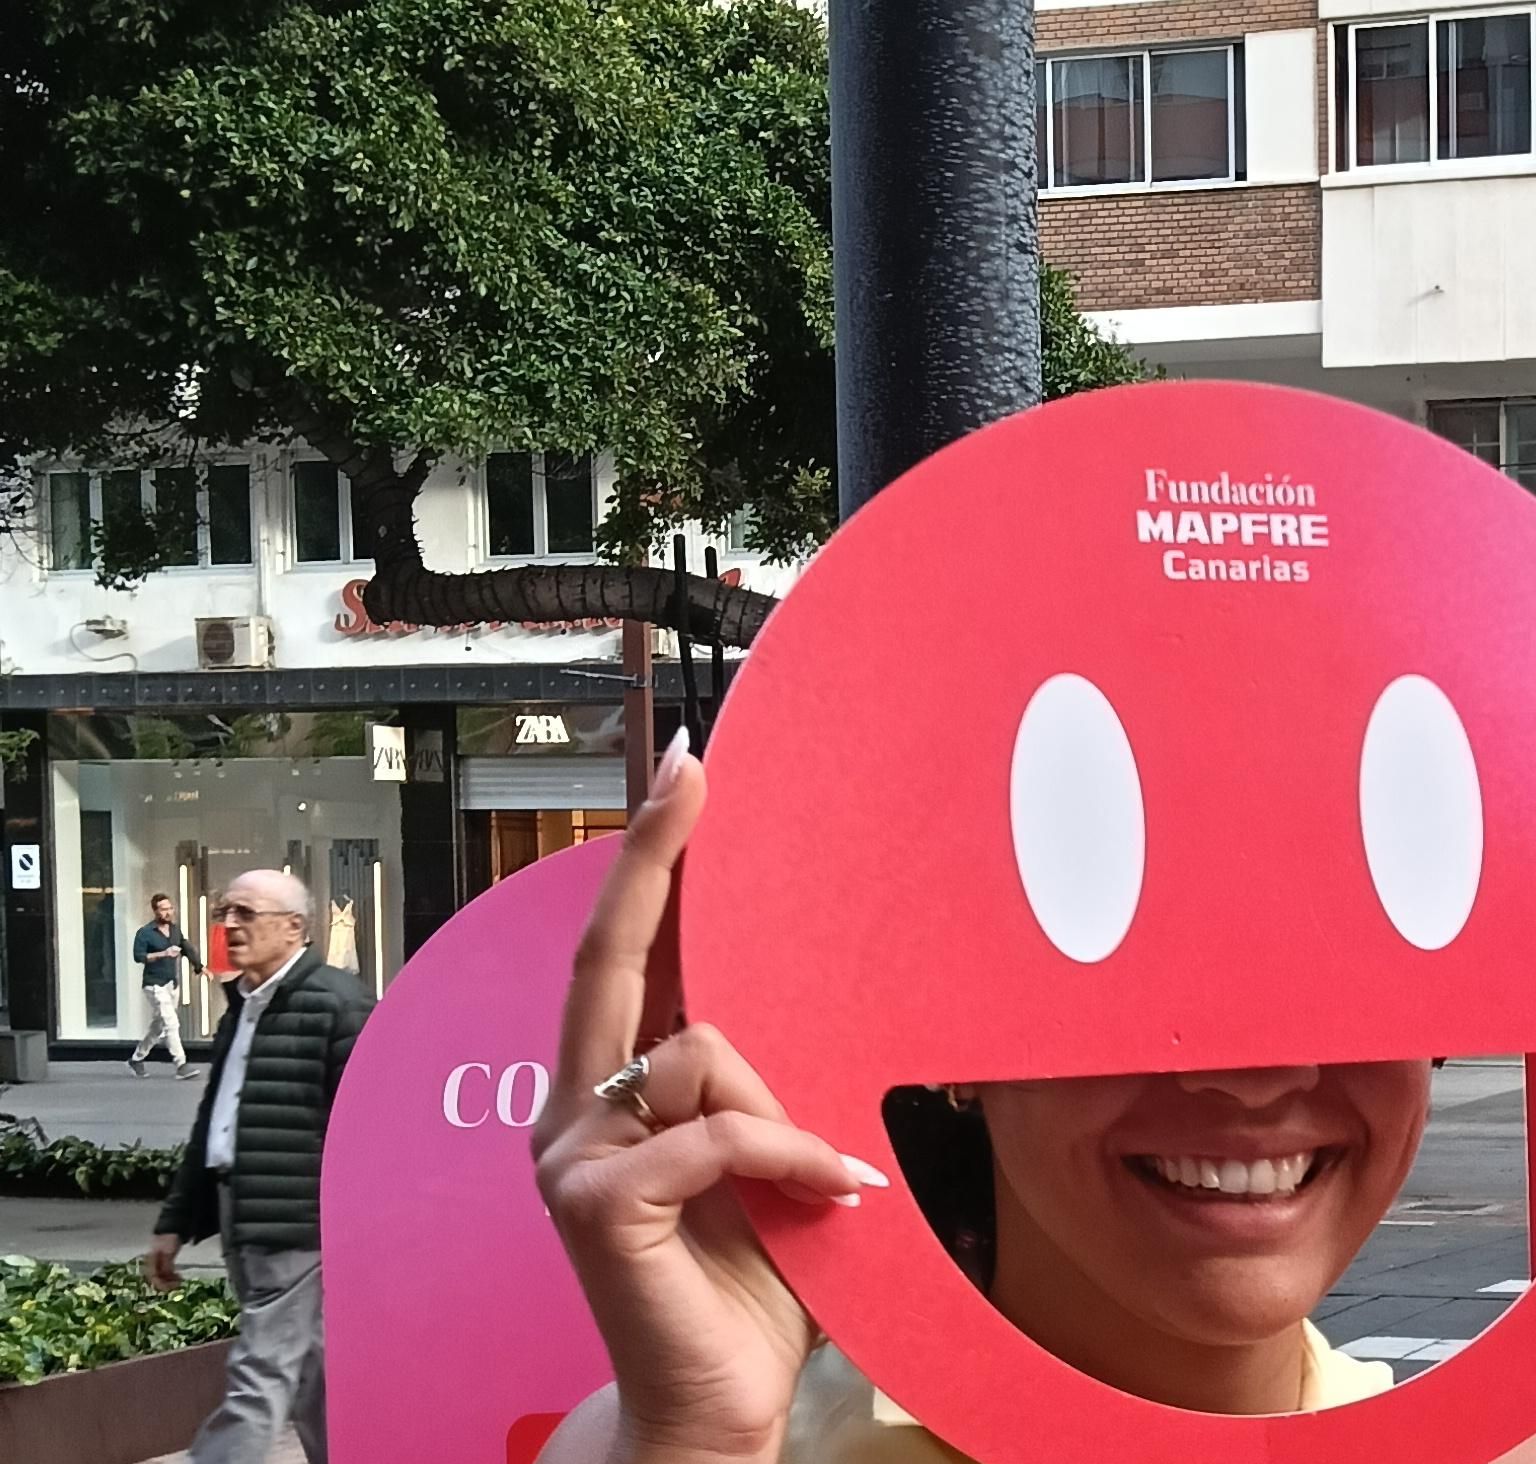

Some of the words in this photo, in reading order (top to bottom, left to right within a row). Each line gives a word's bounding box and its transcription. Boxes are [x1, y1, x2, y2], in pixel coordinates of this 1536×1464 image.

[1145, 468, 1316, 506] Fundación
[1136, 510, 1329, 547] MAPFRE
[1162, 550, 1310, 582] Canarias
[515, 715, 570, 743] ZARA
